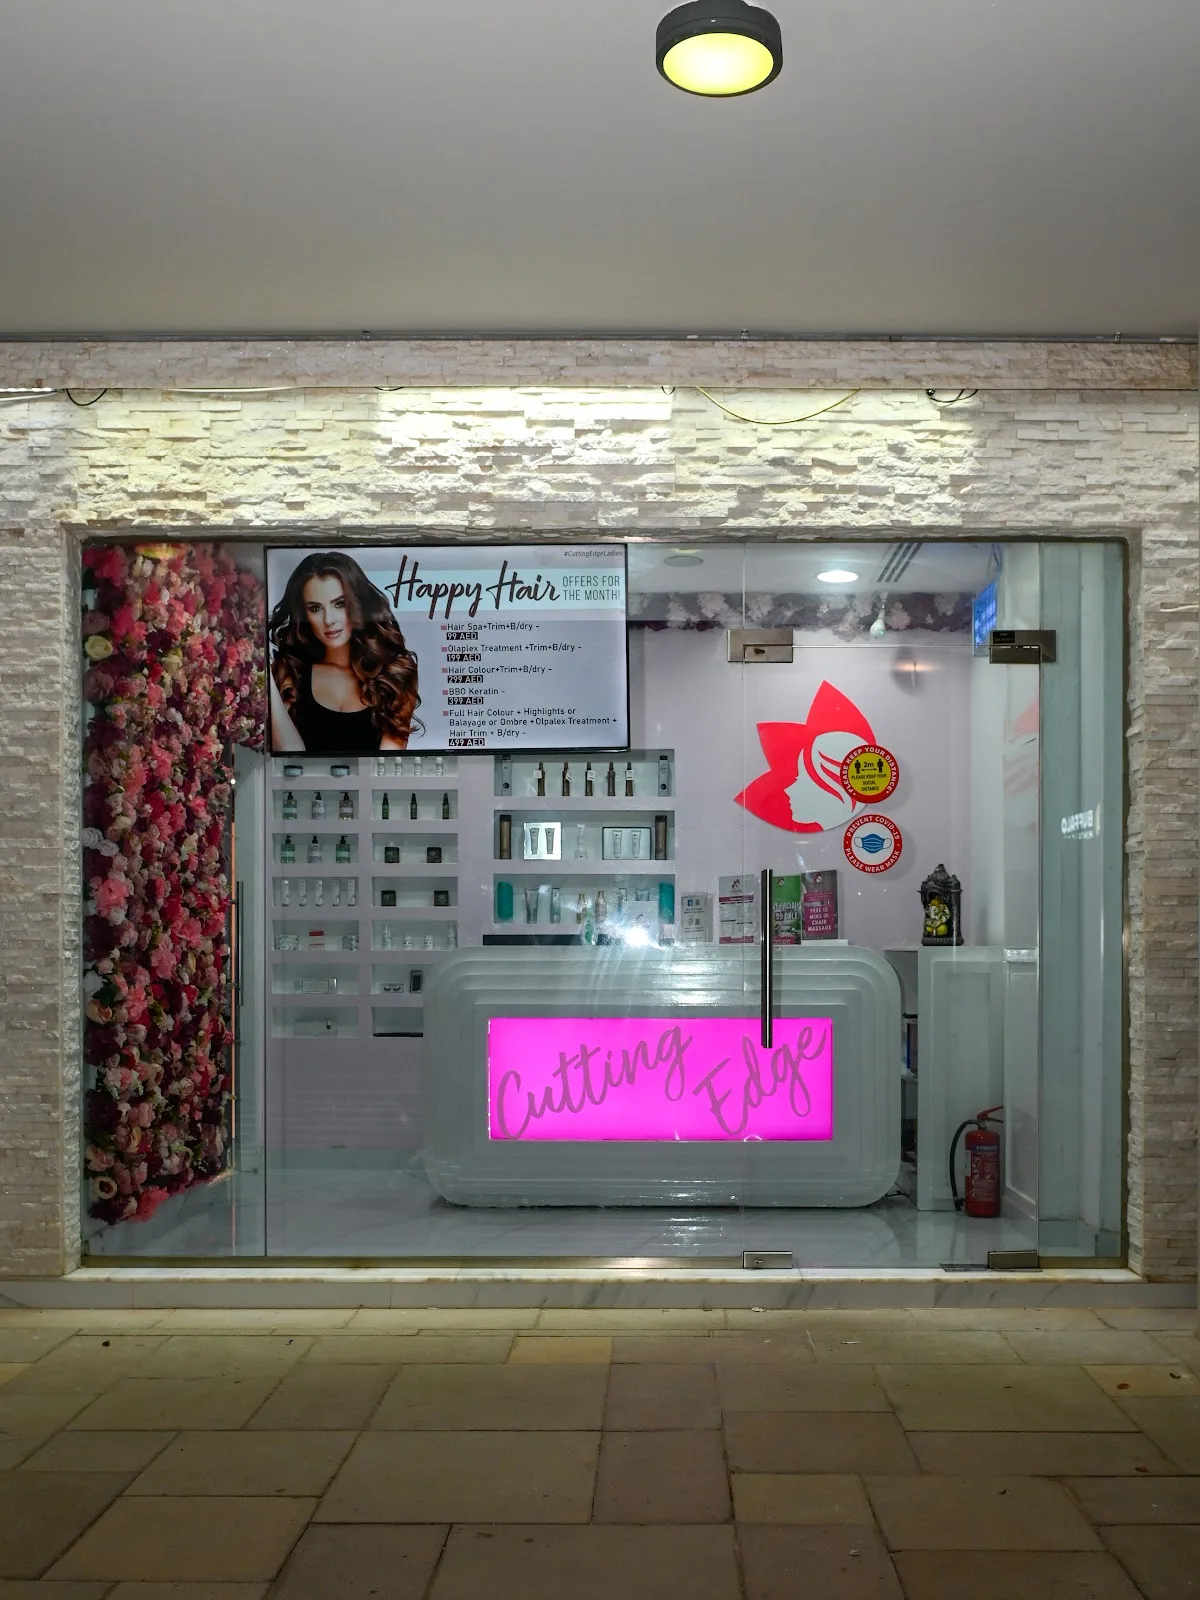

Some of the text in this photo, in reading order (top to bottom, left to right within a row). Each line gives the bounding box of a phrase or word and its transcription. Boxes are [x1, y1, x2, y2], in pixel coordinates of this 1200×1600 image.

[384, 554, 560, 620] Happy Hair
[562, 575, 620, 587] OFFERS FOR
[562, 589, 620, 600] THE MONTH!
[448, 644, 478, 654] Olaplex
[524, 708, 565, 716] Highlights
[449, 718, 486, 727] Balayage
[497, 728, 520, 737] B/dry
[842, 746, 897, 793] PLEASE KEEP YOUR DISTANCE
[846, 816, 900, 840] PREVENT COVID-19
[845, 848, 864, 870] PLEASE
[885, 850, 900, 868] MASK
[497, 1025, 827, 1139] Cutting Edge
